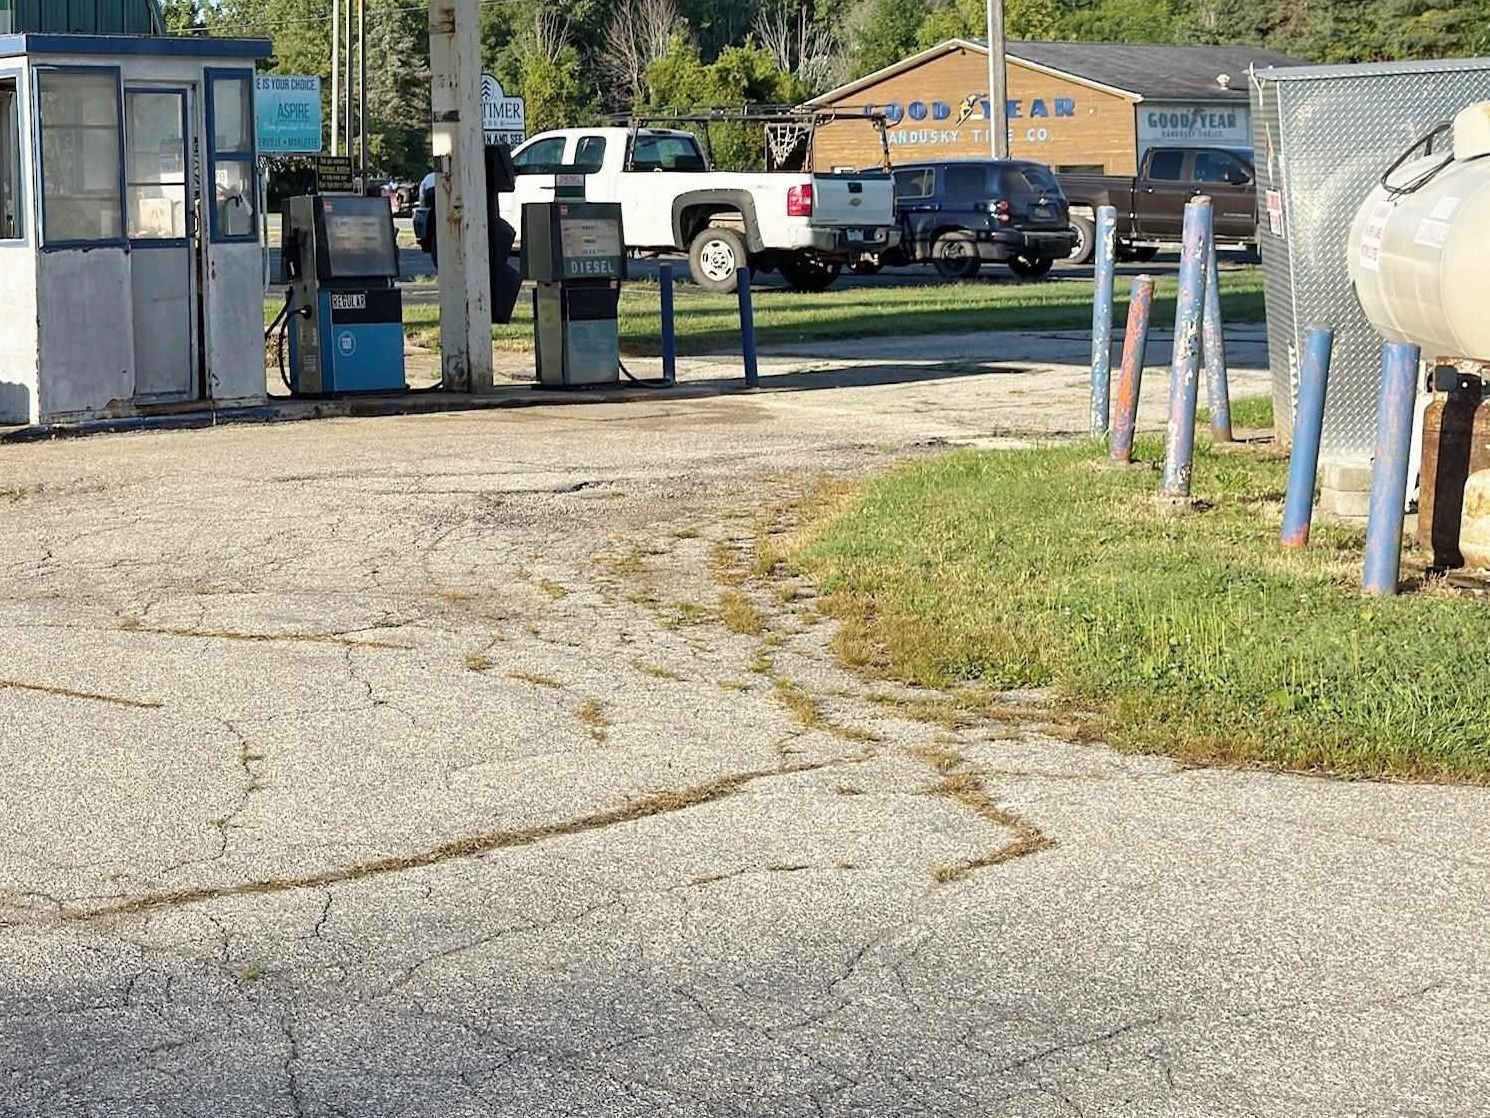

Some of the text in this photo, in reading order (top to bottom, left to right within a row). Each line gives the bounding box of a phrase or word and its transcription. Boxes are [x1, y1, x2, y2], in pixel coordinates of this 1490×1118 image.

[263, 78, 269, 90] IS
[272, 78, 289, 90] YOUR
[278, 103, 310, 119] ASPIRE
[494, 133, 508, 145] AND
[511, 133, 523, 145] SEE
[879, 128, 959, 146] ANDUSKY
[972, 129, 1014, 143] TIE
[571, 260, 614, 273] DIESEL
[333, 295, 365, 308] REGULAR
